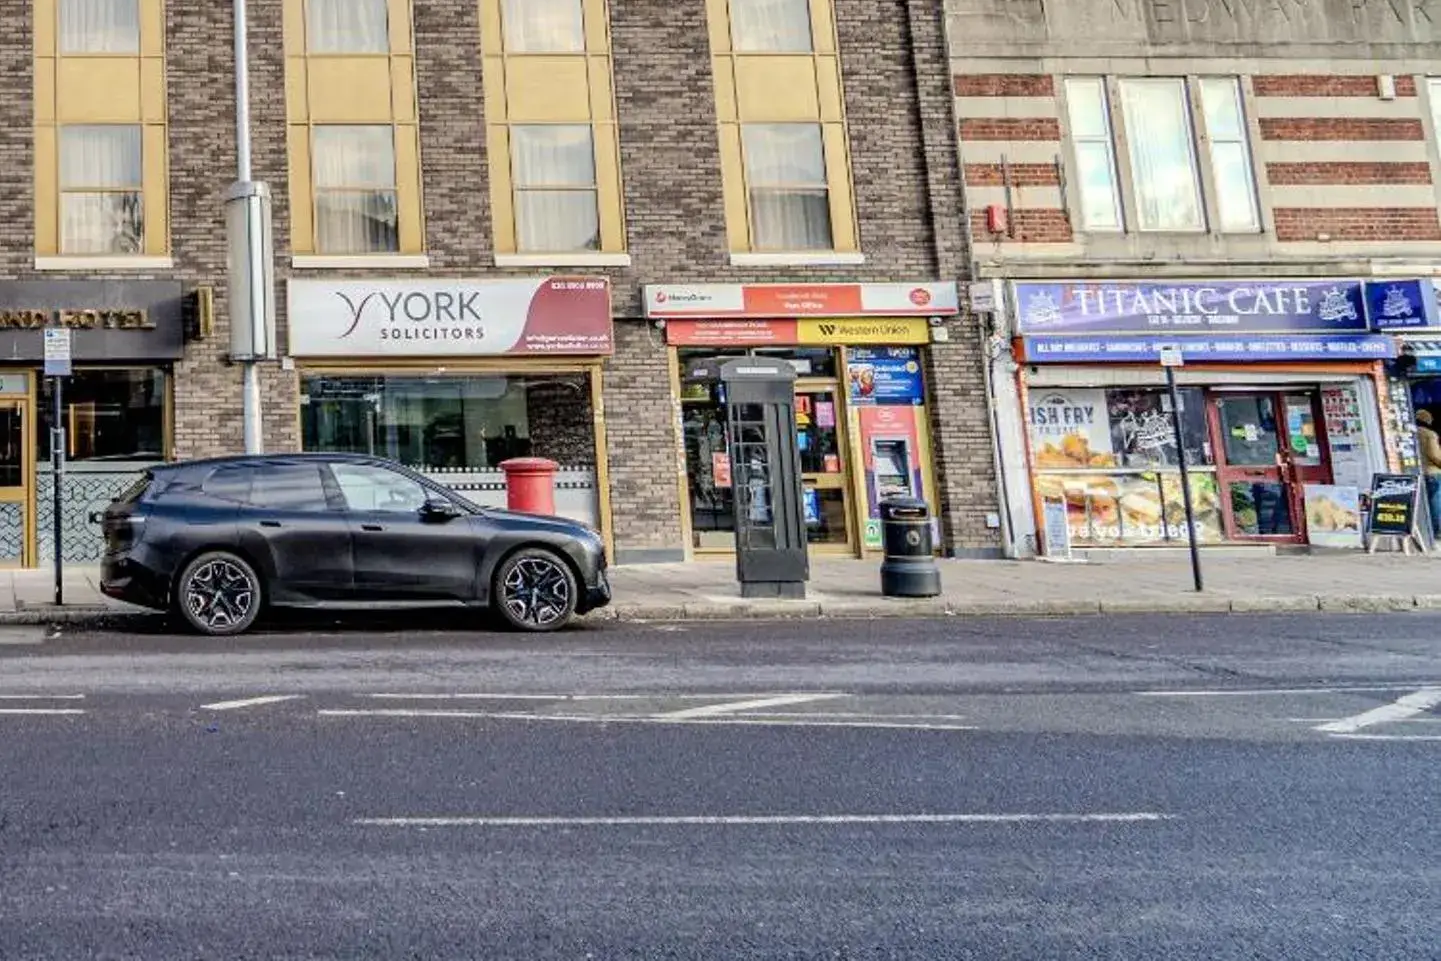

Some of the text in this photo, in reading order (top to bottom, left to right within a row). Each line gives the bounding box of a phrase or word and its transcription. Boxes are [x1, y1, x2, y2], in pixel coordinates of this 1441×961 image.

[379, 291, 482, 321] YORK
[1072, 288, 1219, 316] TITANIC
[1228, 286, 1311, 315] CAFE
[56, 309, 157, 331] HOTEL
[380, 327, 484, 339] SOLICITORS
[1064, 407, 1094, 424] FRY
